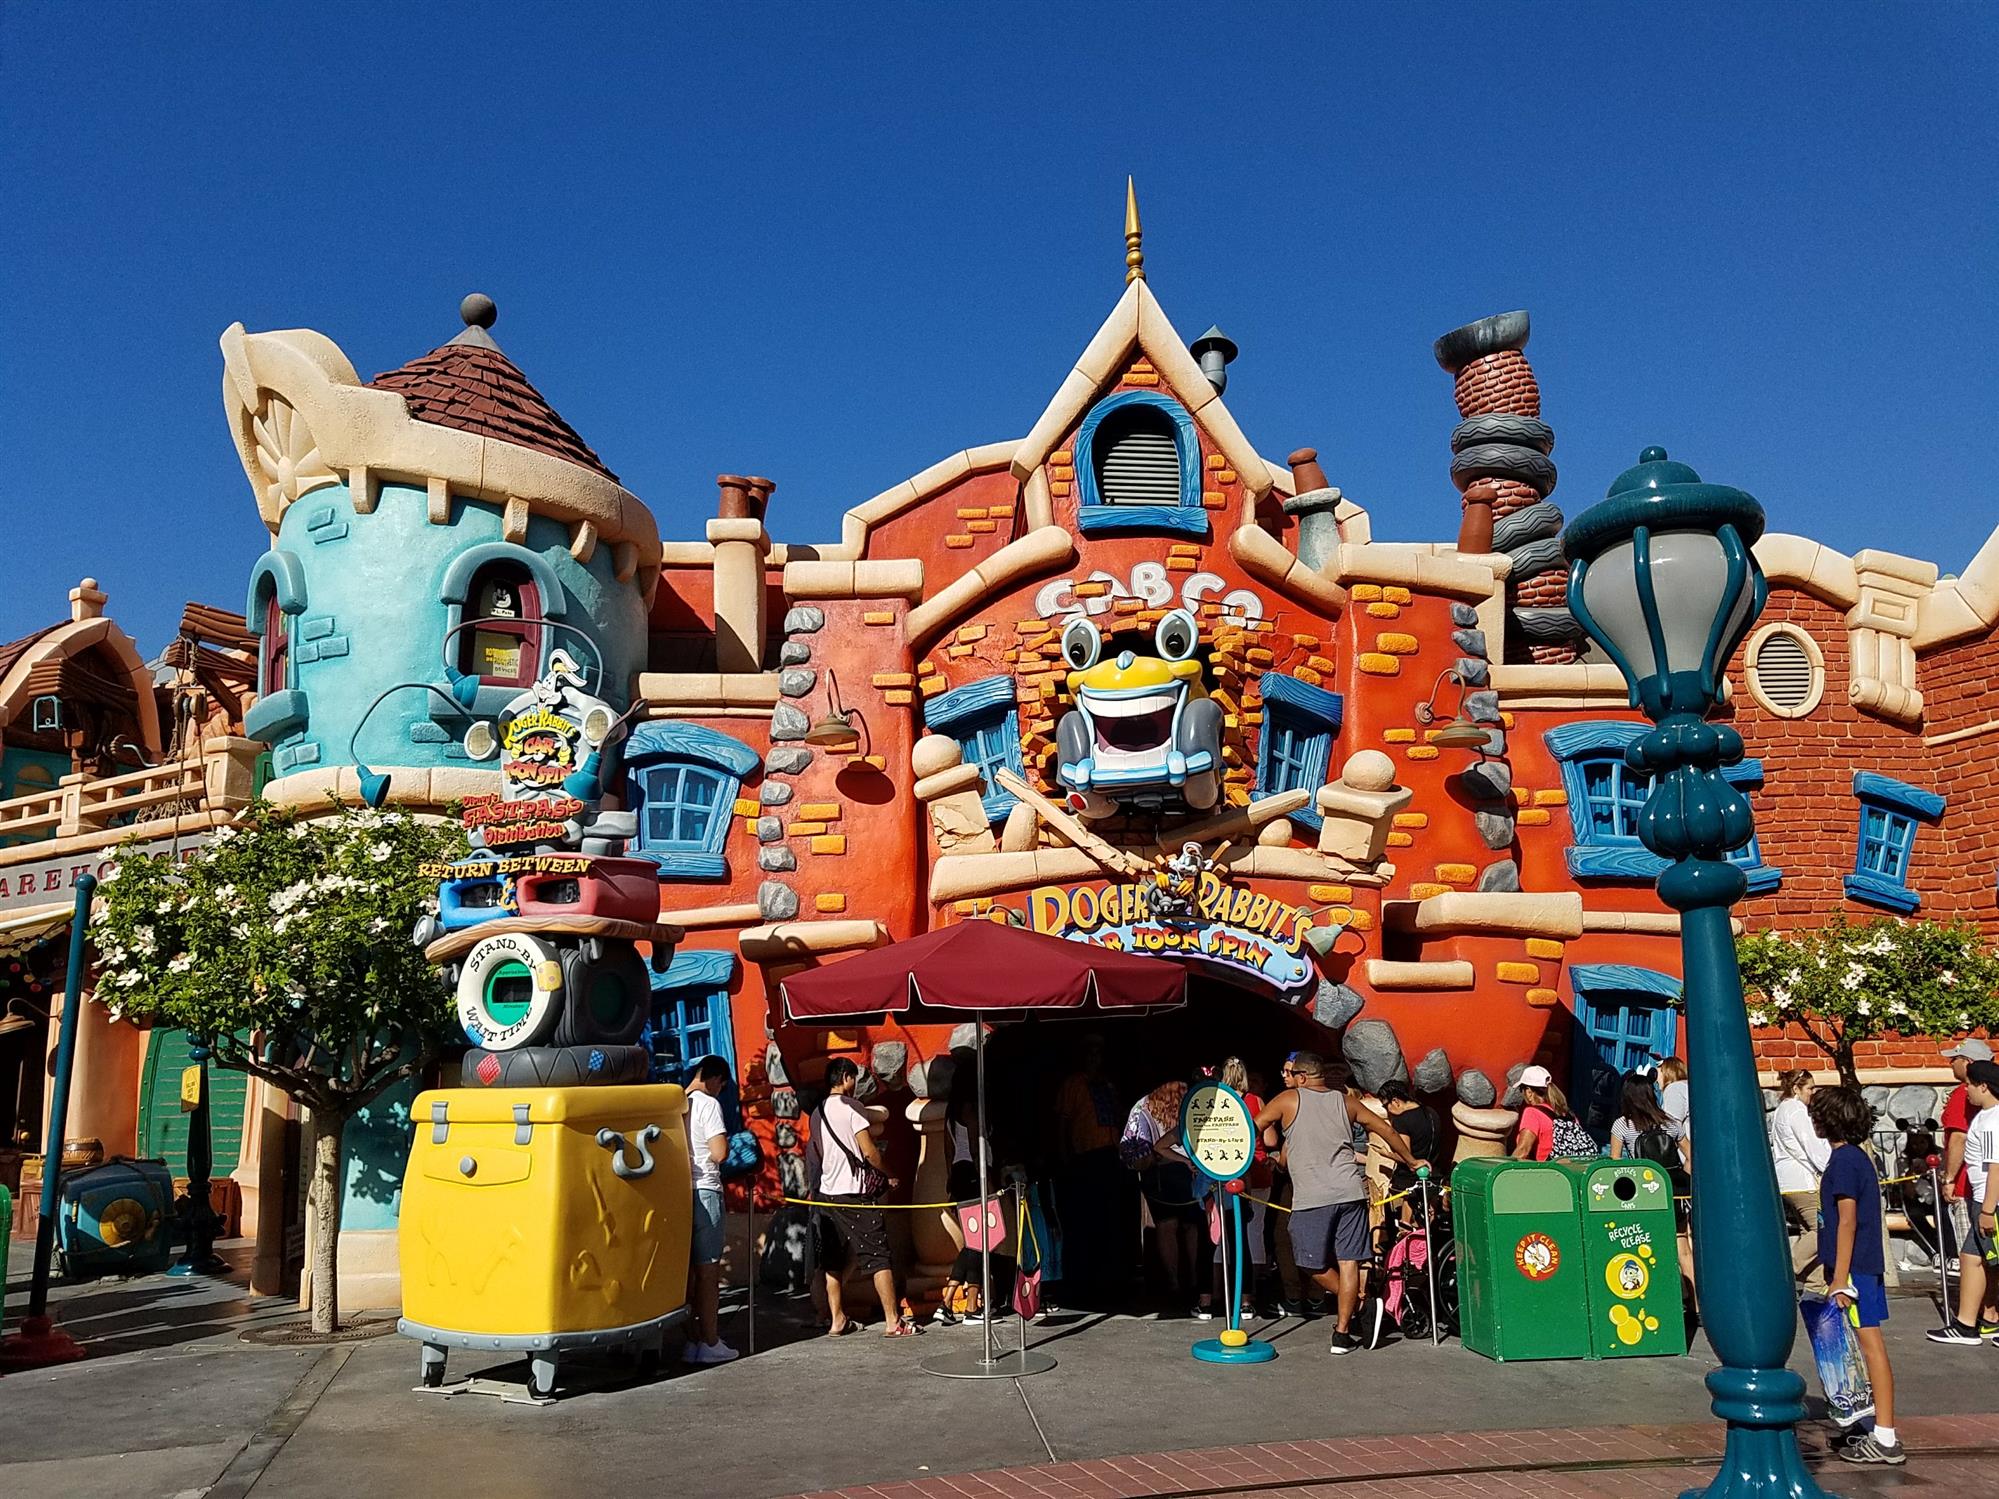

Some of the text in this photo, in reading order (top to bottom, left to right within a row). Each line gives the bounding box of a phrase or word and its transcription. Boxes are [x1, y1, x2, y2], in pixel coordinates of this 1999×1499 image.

[498, 712, 538, 750] ROGER
[524, 736, 556, 756] CAR
[537, 763, 574, 785] SPIN
[463, 799, 583, 829] FASTPASS
[417, 856, 592, 879] RETURN BETWEEN
[1030, 871, 1314, 954] ROGER RABBIT'S
[470, 938, 537, 972] STAND-BY
[1131, 926, 1201, 952] TOON
[1209, 929, 1272, 968] SPIN
[466, 1006, 532, 1042] WAIT TIME
[1193, 1115, 1235, 1123] FASTPASS
[1614, 1168, 1637, 1177] BOTTLES
[1608, 1223, 1644, 1242] RECYCLE
[1621, 1232, 1652, 1249] PLEASE
[1516, 1233, 1559, 1266] KEEP IT CLEAN
